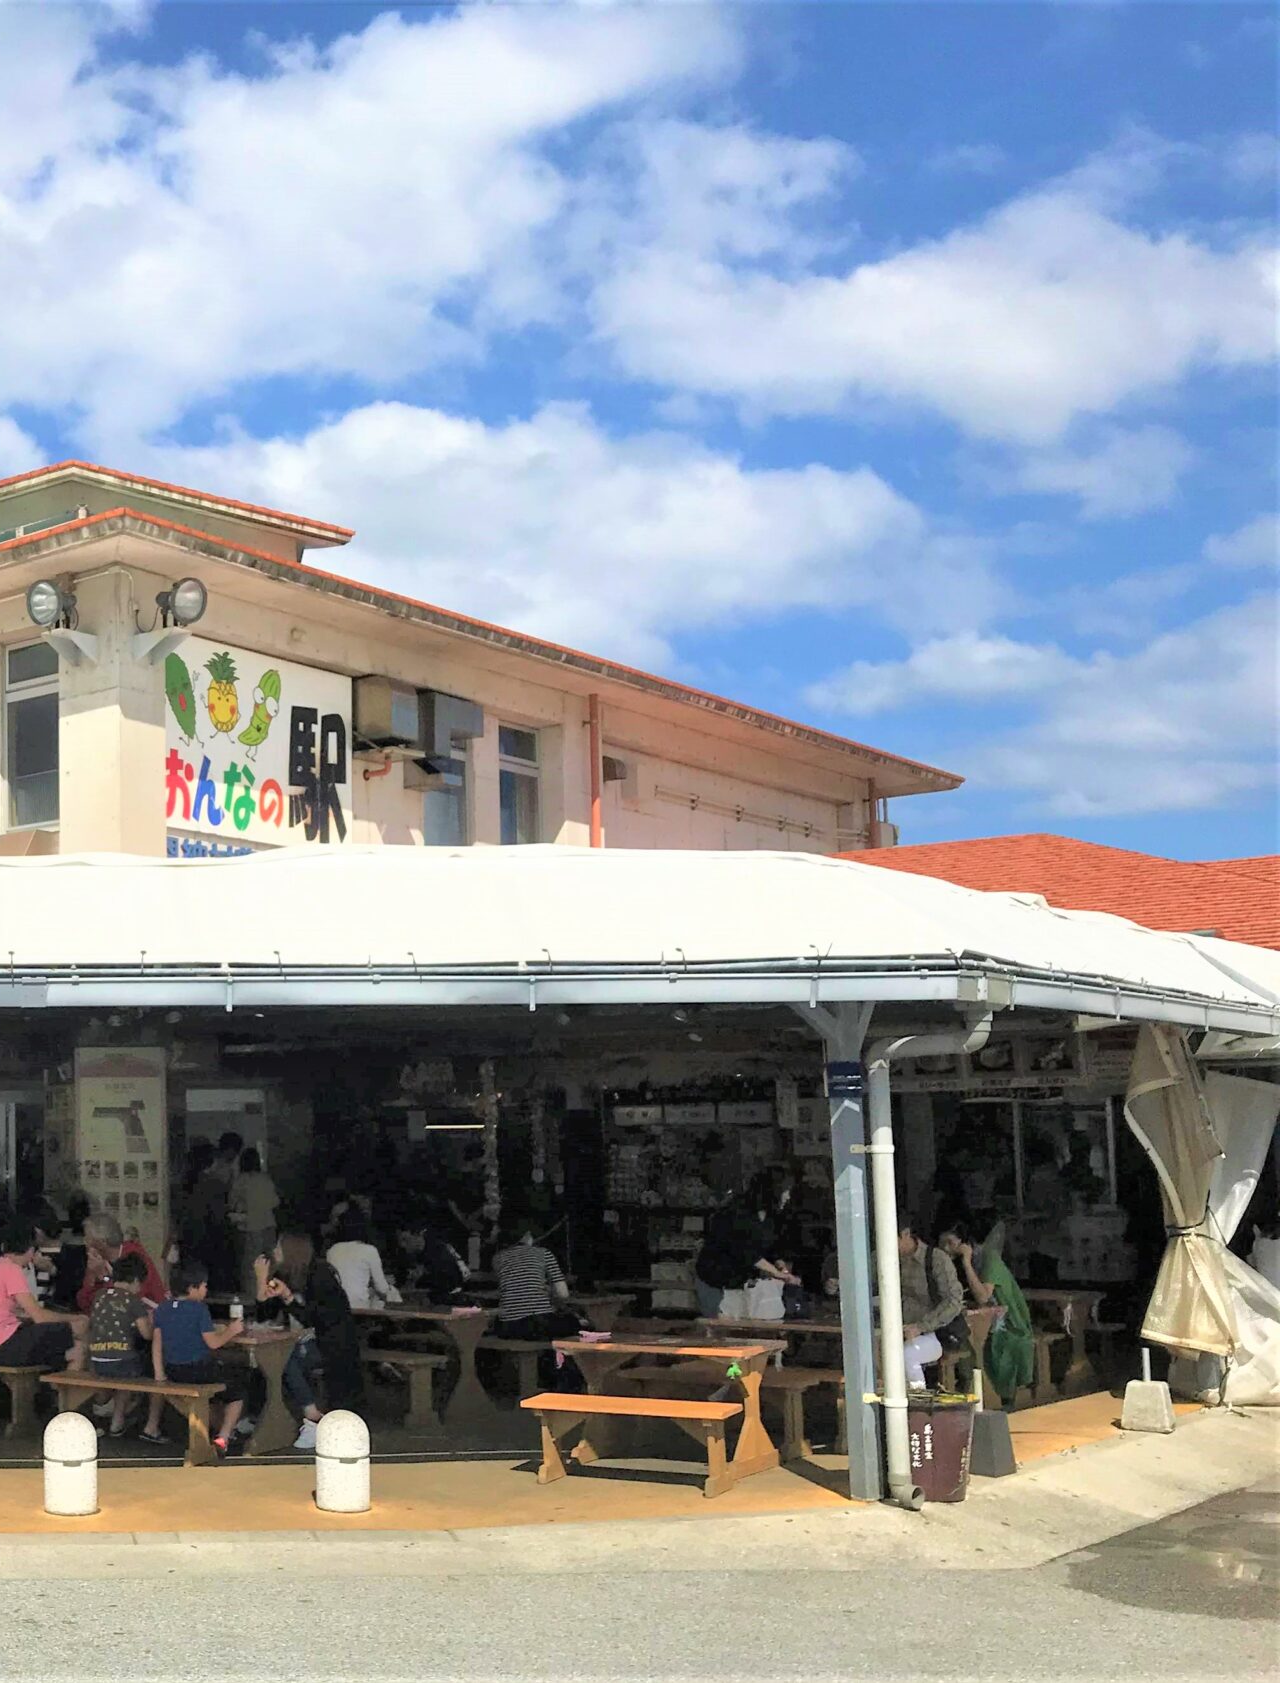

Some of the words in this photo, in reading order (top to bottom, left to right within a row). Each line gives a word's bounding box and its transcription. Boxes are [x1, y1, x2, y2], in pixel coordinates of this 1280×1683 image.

[166, 706, 347, 843] おんなの駅
